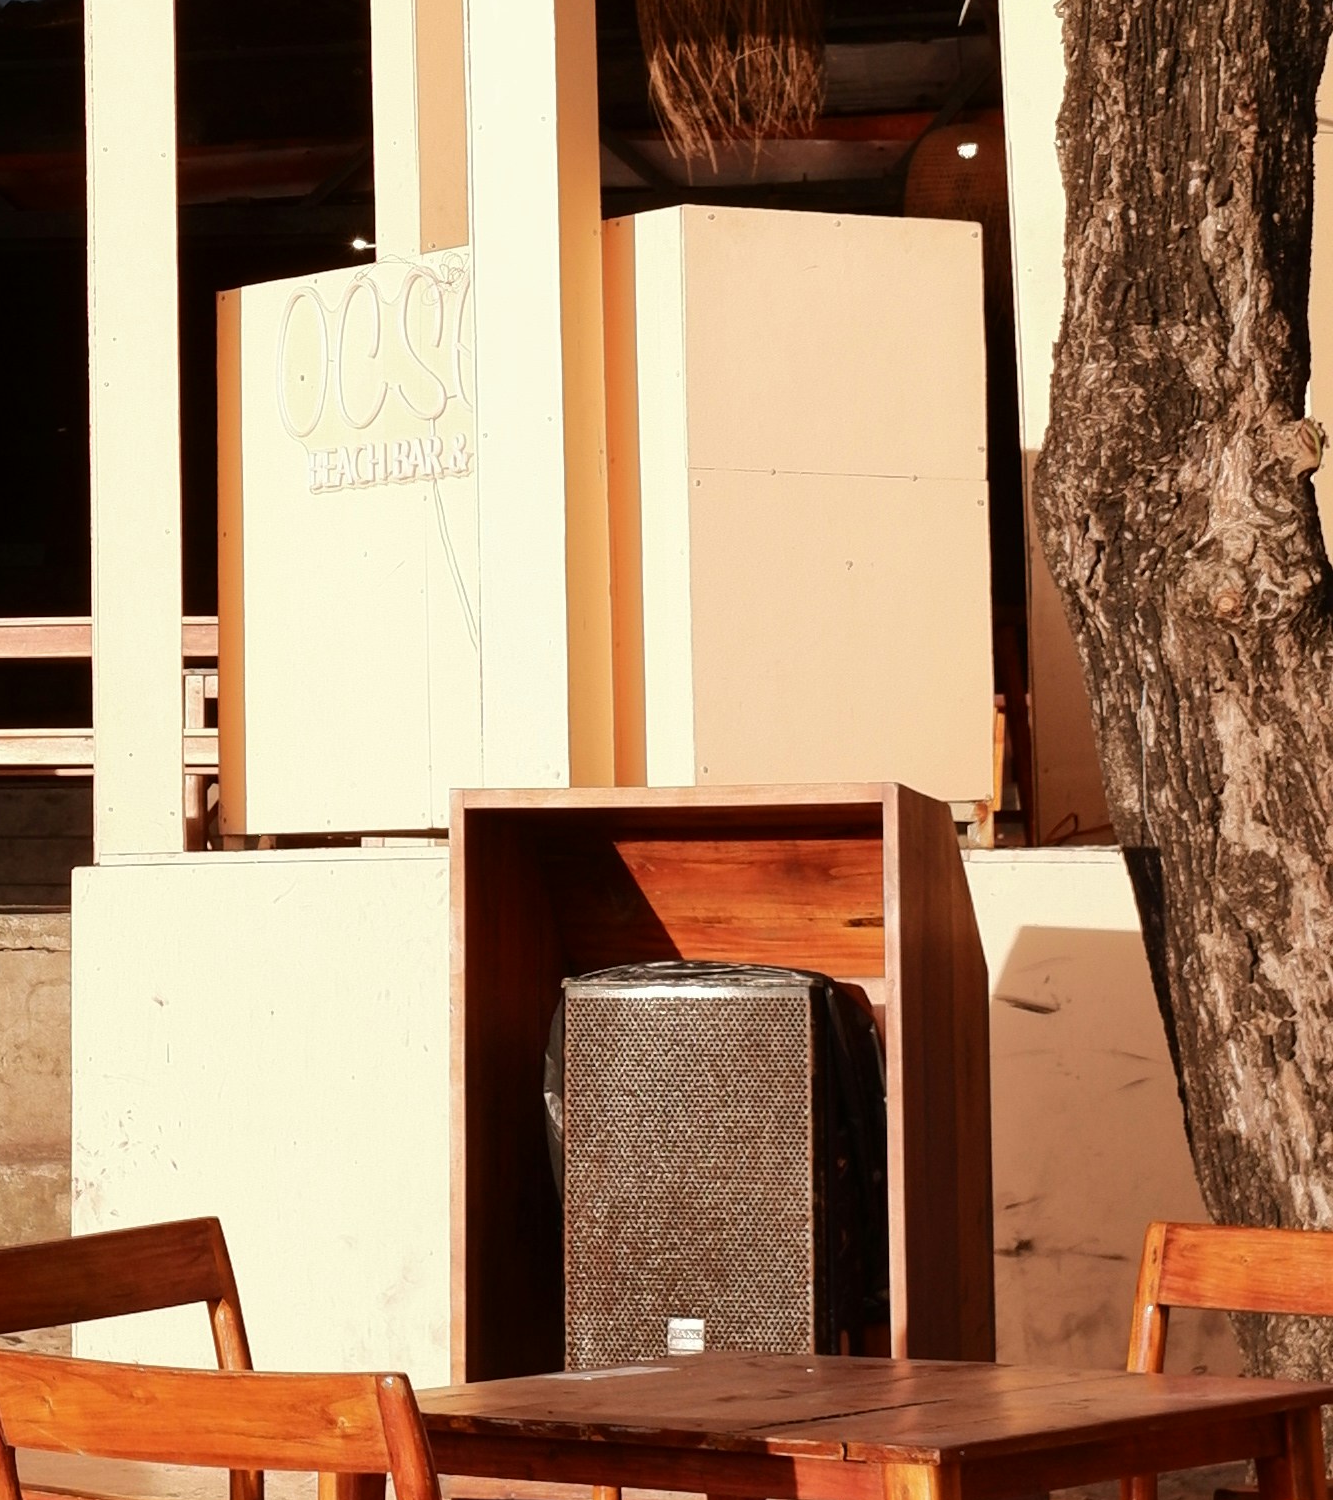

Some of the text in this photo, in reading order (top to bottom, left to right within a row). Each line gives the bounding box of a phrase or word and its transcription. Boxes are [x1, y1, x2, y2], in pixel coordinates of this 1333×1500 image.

[308, 432, 474, 488] BEACH BAR &
